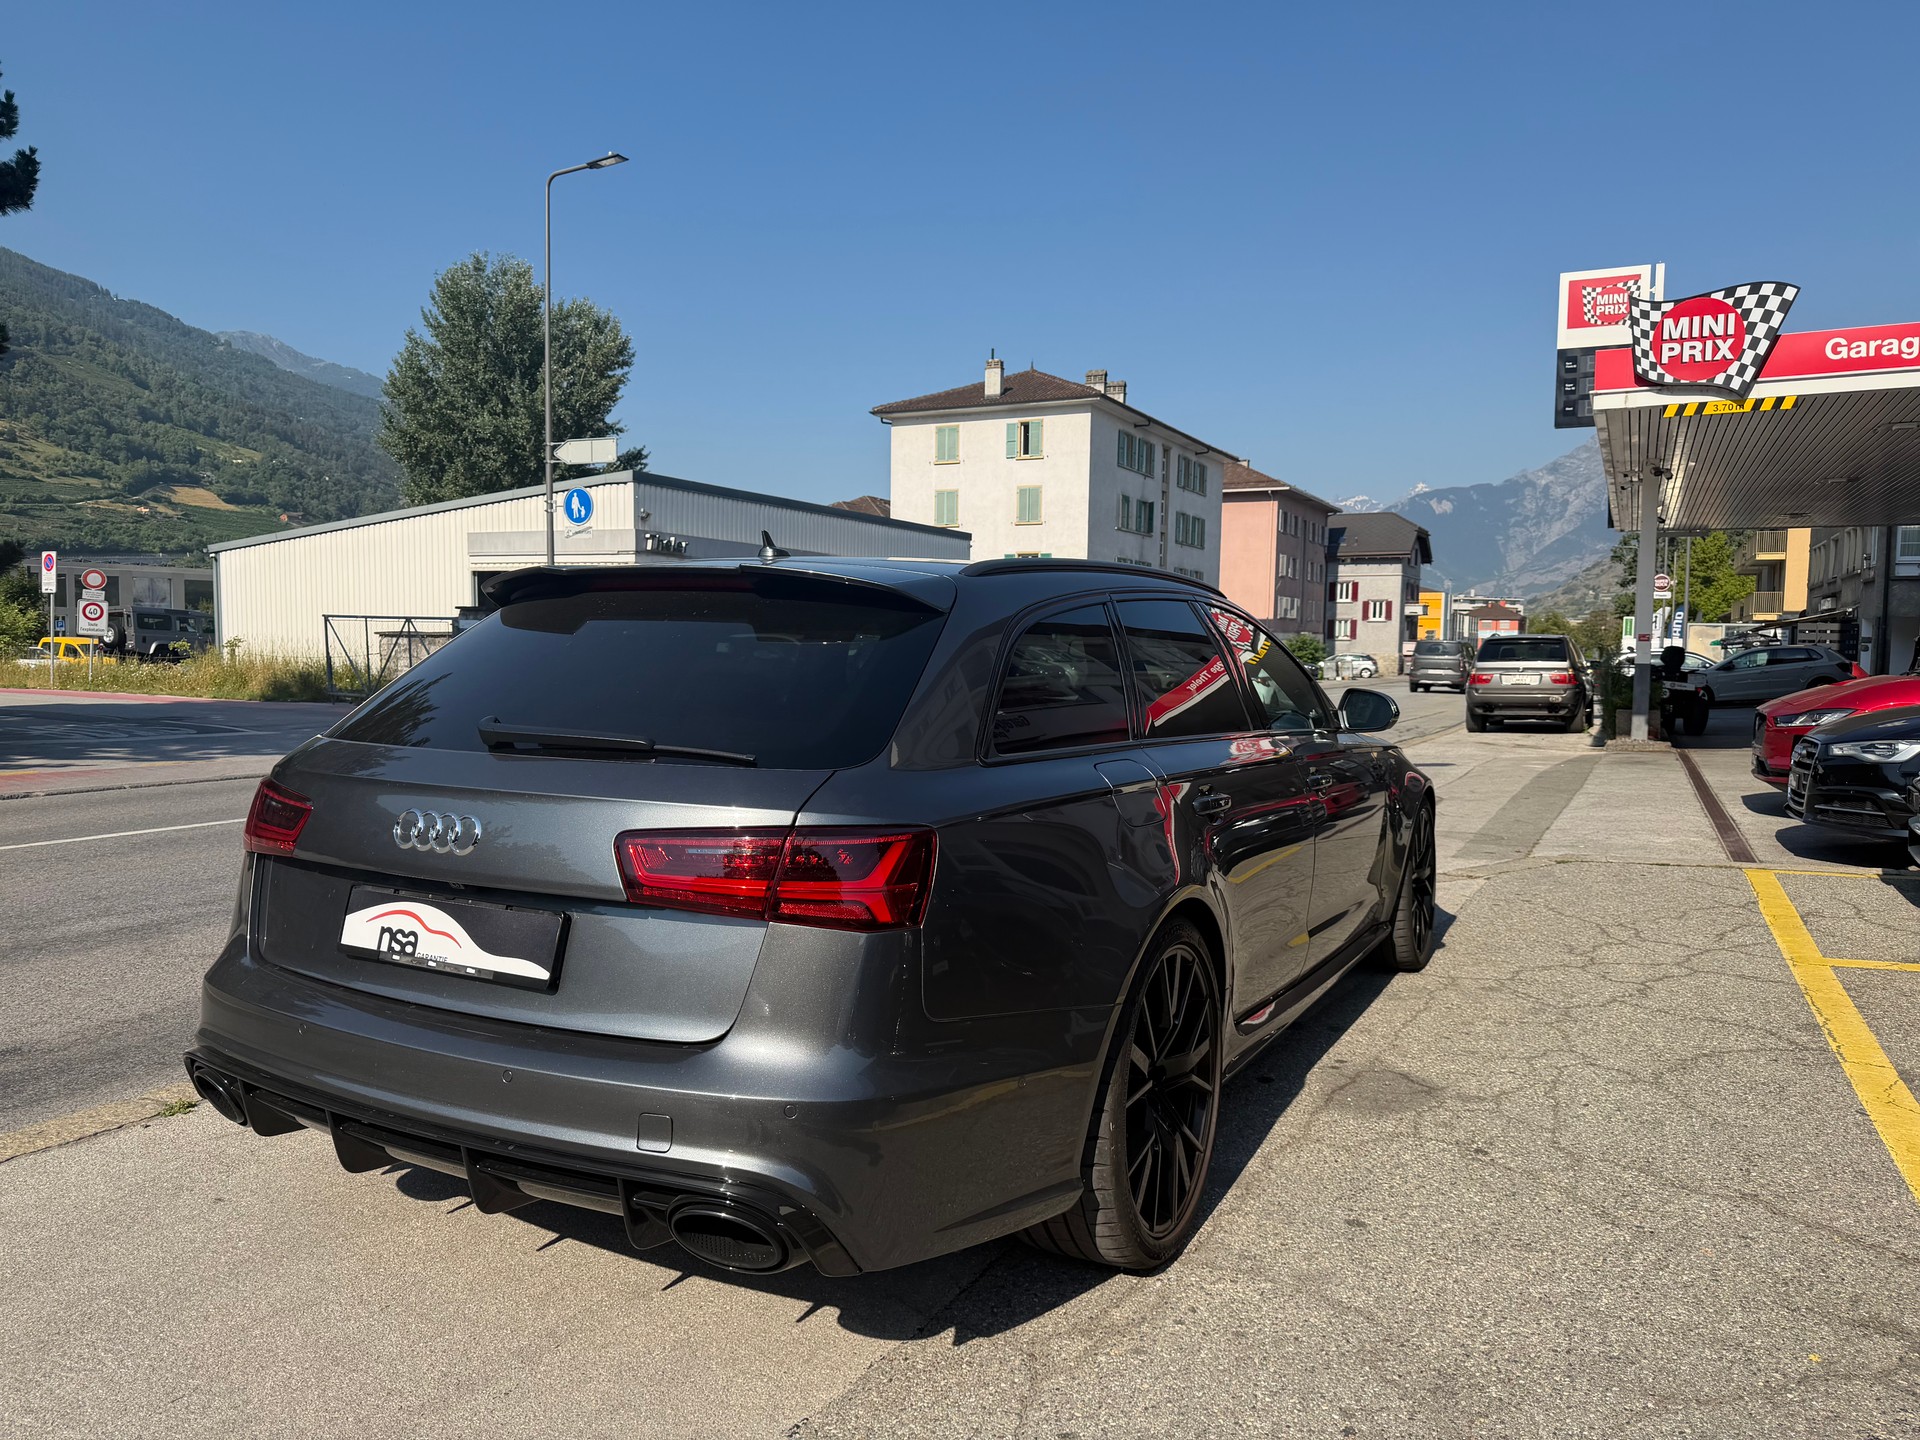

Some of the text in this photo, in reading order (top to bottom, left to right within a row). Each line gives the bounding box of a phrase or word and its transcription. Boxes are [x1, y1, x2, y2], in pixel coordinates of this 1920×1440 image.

[1596, 293, 1628, 305] MINI
[1595, 303, 1628, 316] PRIX
[1661, 313, 1736, 341] MINI
[1660, 338, 1735, 365] PRIX
[1712, 403, 1734, 413] 3.70
[88, 608, 98, 616] 40
[376, 925, 418, 957] nsa
